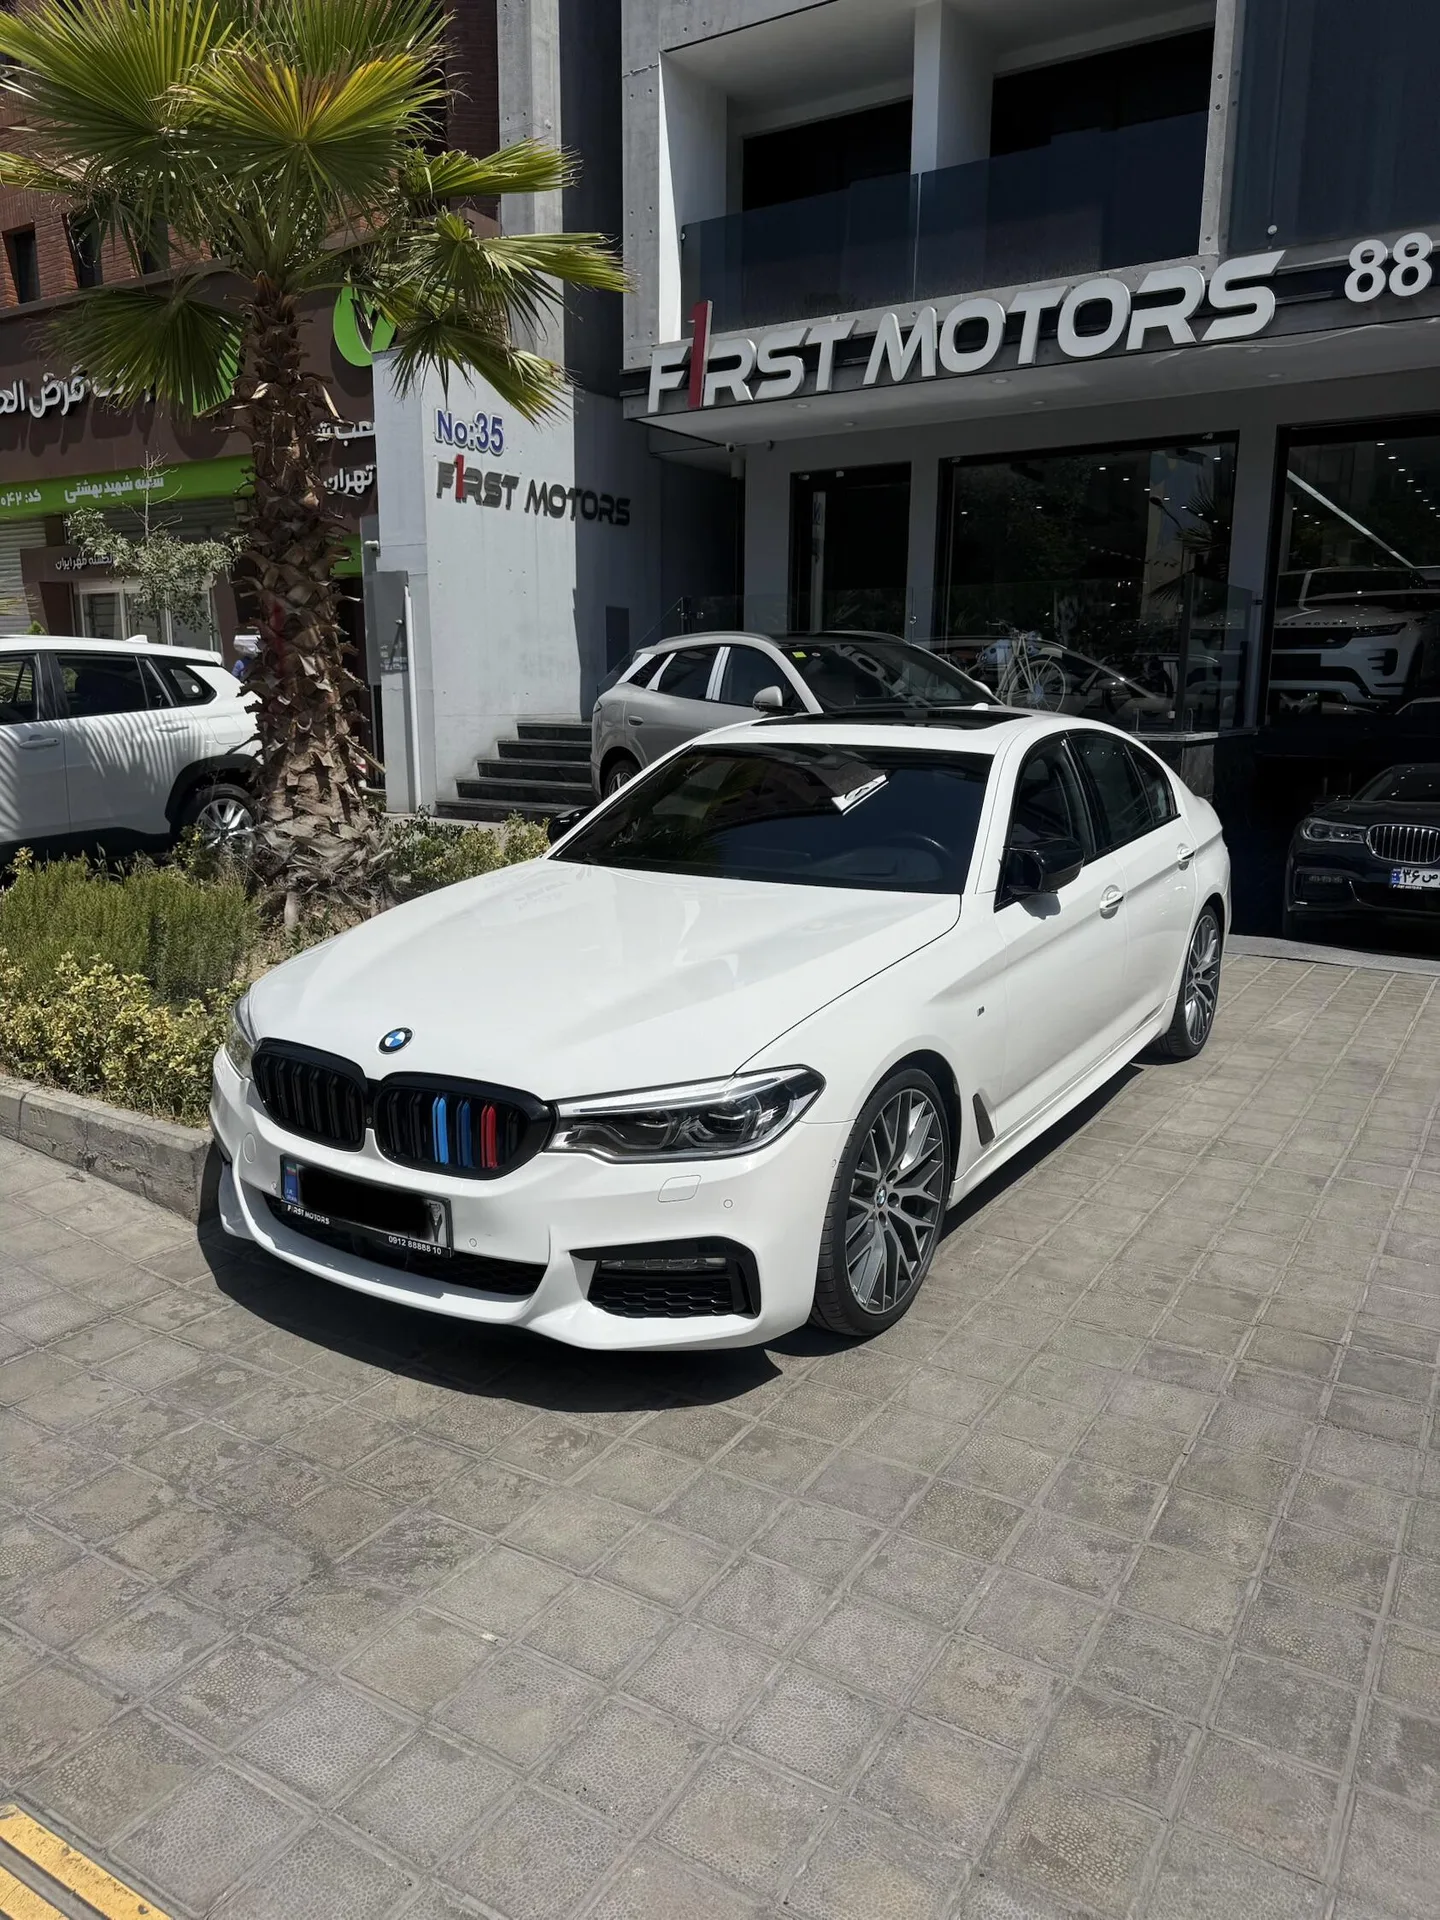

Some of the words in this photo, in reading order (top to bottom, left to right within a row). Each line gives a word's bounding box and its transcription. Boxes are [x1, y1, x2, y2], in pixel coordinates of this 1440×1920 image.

[1343, 232, 1434, 303] 88
[863, 250, 1287, 385] MOTORS
[435, 408, 504, 456] No:35
[524, 478, 631, 526] MOTORS
[304, 1210, 330, 1225] MOTORS
[388, 1235, 406, 1247] 0912
[433, 1246, 442, 1255] 10
